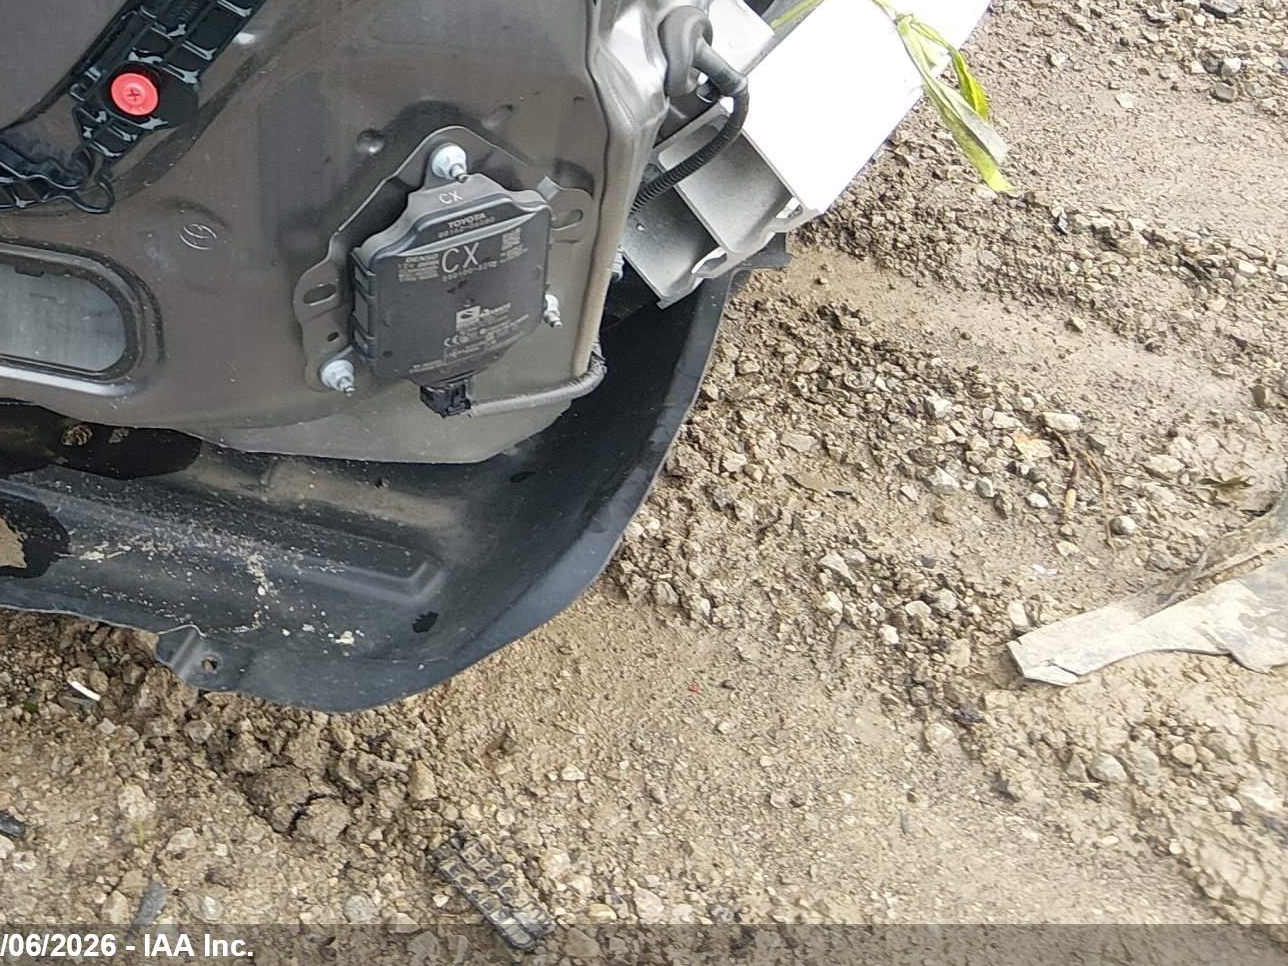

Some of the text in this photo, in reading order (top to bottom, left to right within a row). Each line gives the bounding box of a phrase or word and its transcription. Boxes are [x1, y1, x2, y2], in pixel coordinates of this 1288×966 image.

[438, 190, 464, 205] CX
[447, 212, 487, 229] TOYOTA
[441, 241, 480, 274] CX
